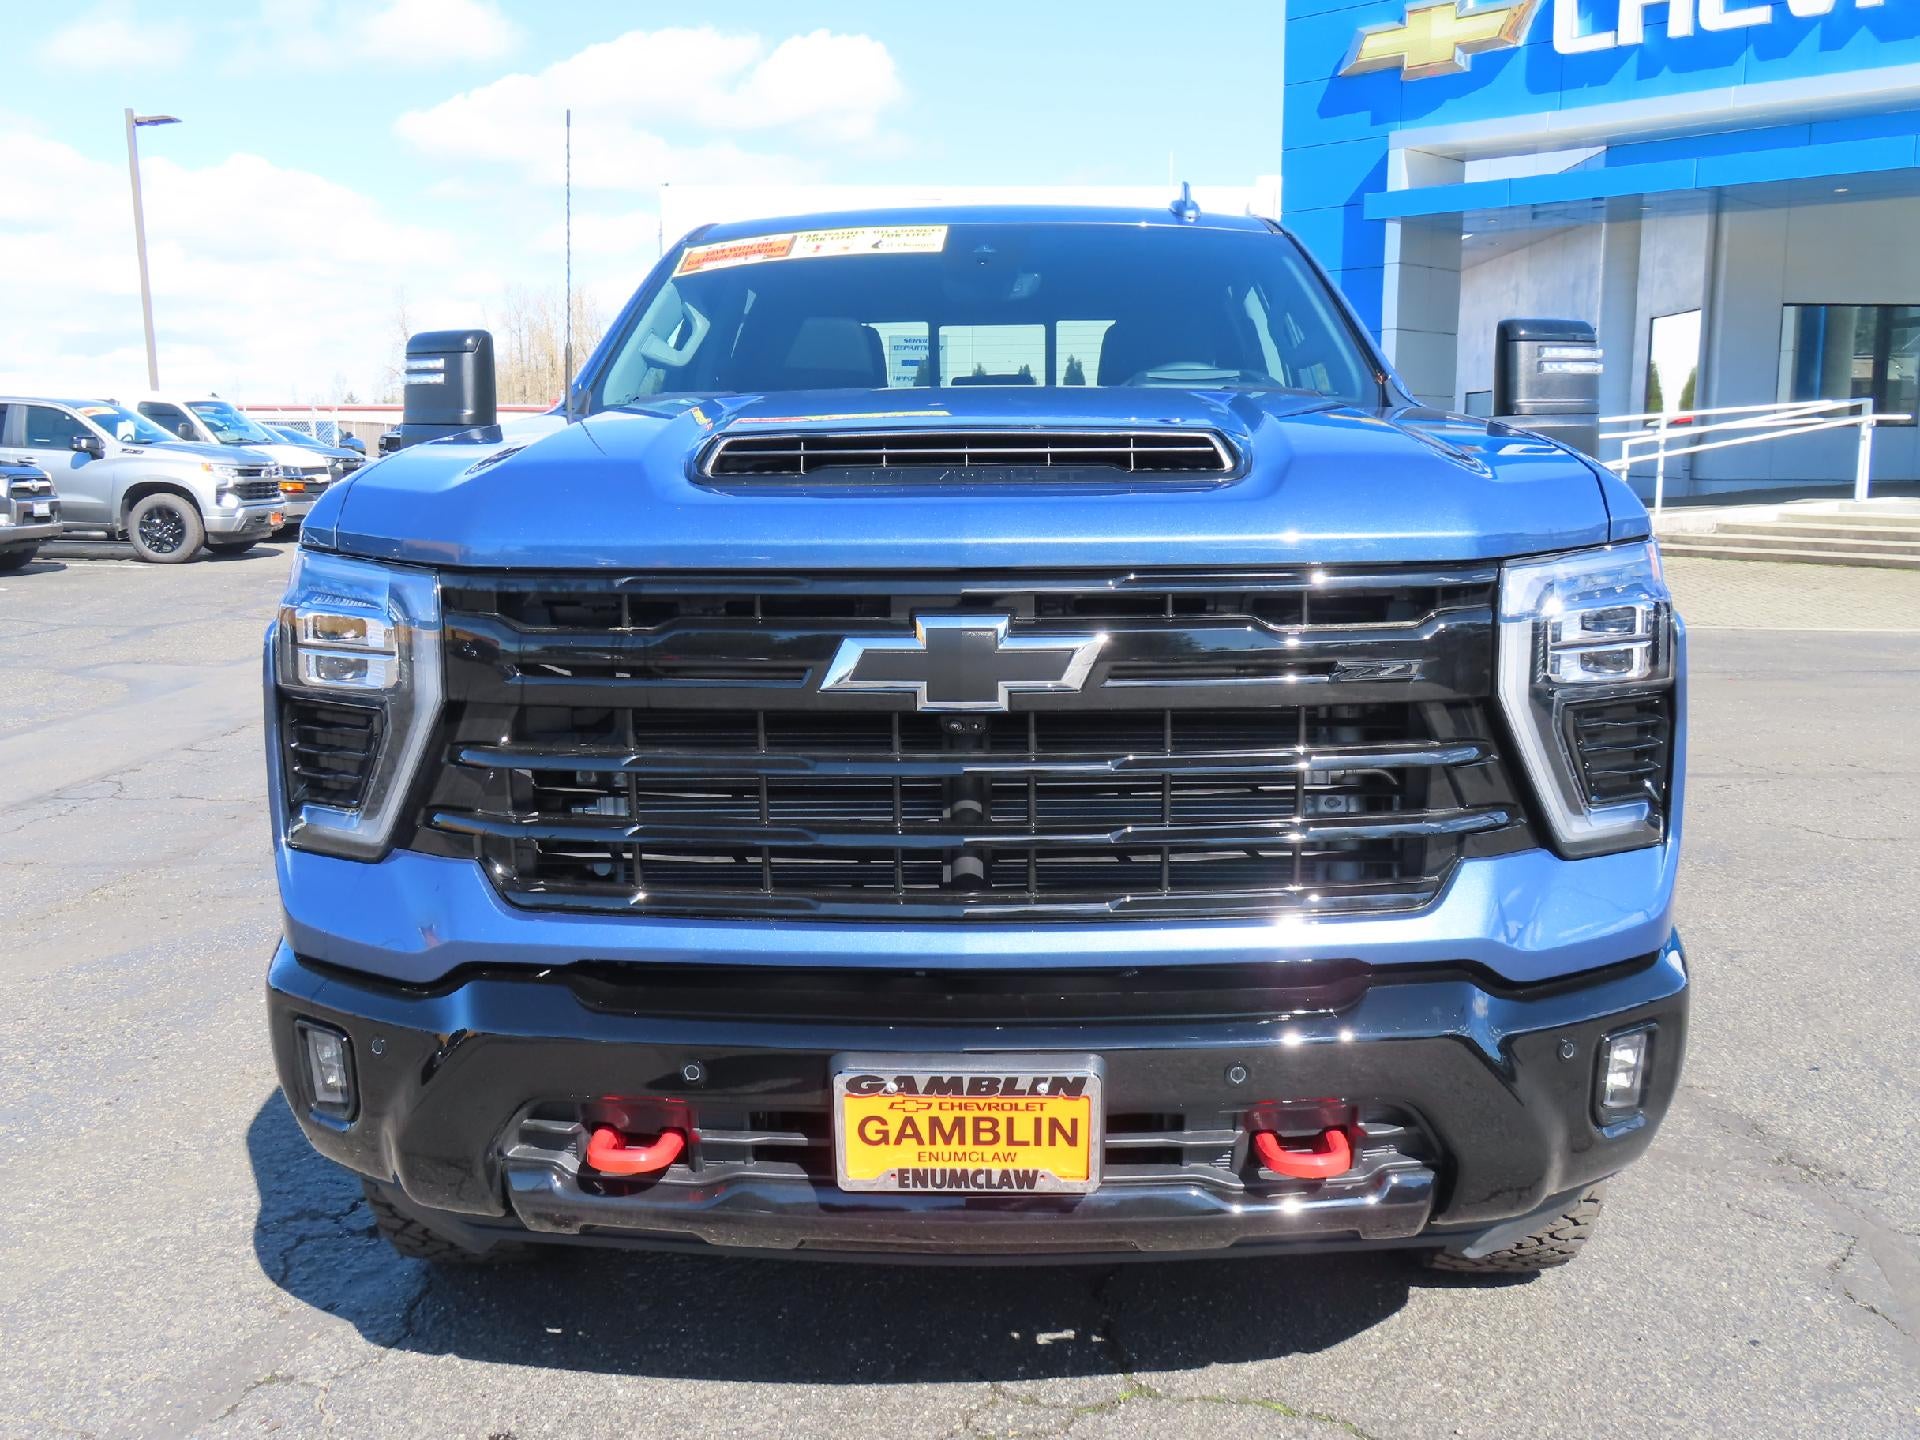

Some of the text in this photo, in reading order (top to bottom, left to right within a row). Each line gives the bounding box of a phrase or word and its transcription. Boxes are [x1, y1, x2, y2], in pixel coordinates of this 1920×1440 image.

[846, 1074, 1087, 1097] GAMBLIN
[938, 1101, 1048, 1112] CHEVROLET
[857, 1115, 1079, 1147] GAMBLIN
[917, 1151, 1017, 1163] ENUMCLAW
[897, 1168, 1040, 1190] ENUMCLAW
